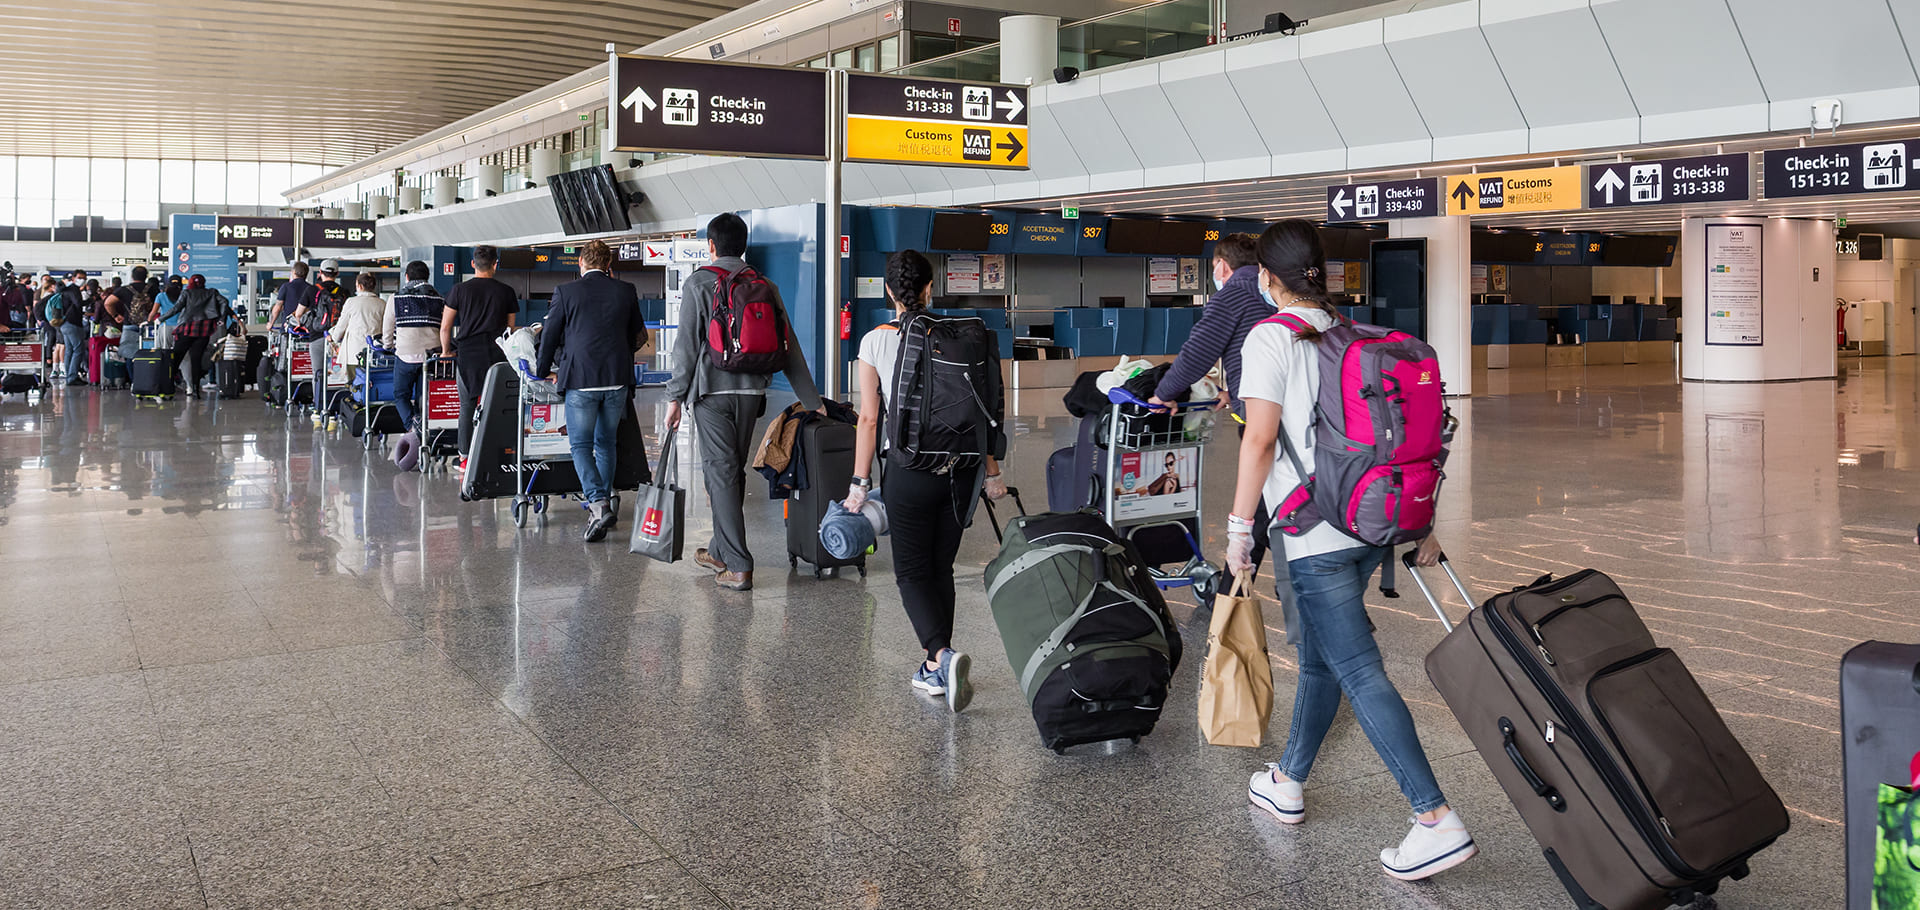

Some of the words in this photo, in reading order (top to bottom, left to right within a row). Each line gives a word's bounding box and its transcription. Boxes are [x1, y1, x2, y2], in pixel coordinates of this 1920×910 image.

[904, 86, 953, 100] Check-in
[710, 95, 766, 110] Check-in
[906, 100, 953, 114] 313-338
[710, 111, 764, 125] 339-430
[905, 128, 953, 141] Customs
[963, 134, 991, 148] VAT
[963, 147, 991, 155] REFUND
[1784, 153, 1850, 171] Check-in
[1673, 163, 1729, 179] Check-in
[1507, 179, 1552, 190] Customs
[1789, 171, 1850, 189] 151-312
[1385, 186, 1425, 199] Check-in
[1479, 182, 1503, 195] VAT
[1673, 180, 1725, 195] 313-338
[1385, 200, 1422, 212] 339-430
[1479, 196, 1503, 204] REFUND
[989, 223, 1009, 235] 338
[1022, 225, 1064, 234] ACCETTAZIONE
[1083, 227, 1102, 238] 337
[1030, 234, 1056, 242] CHECK-IN
[1845, 241, 1857, 253] 326
